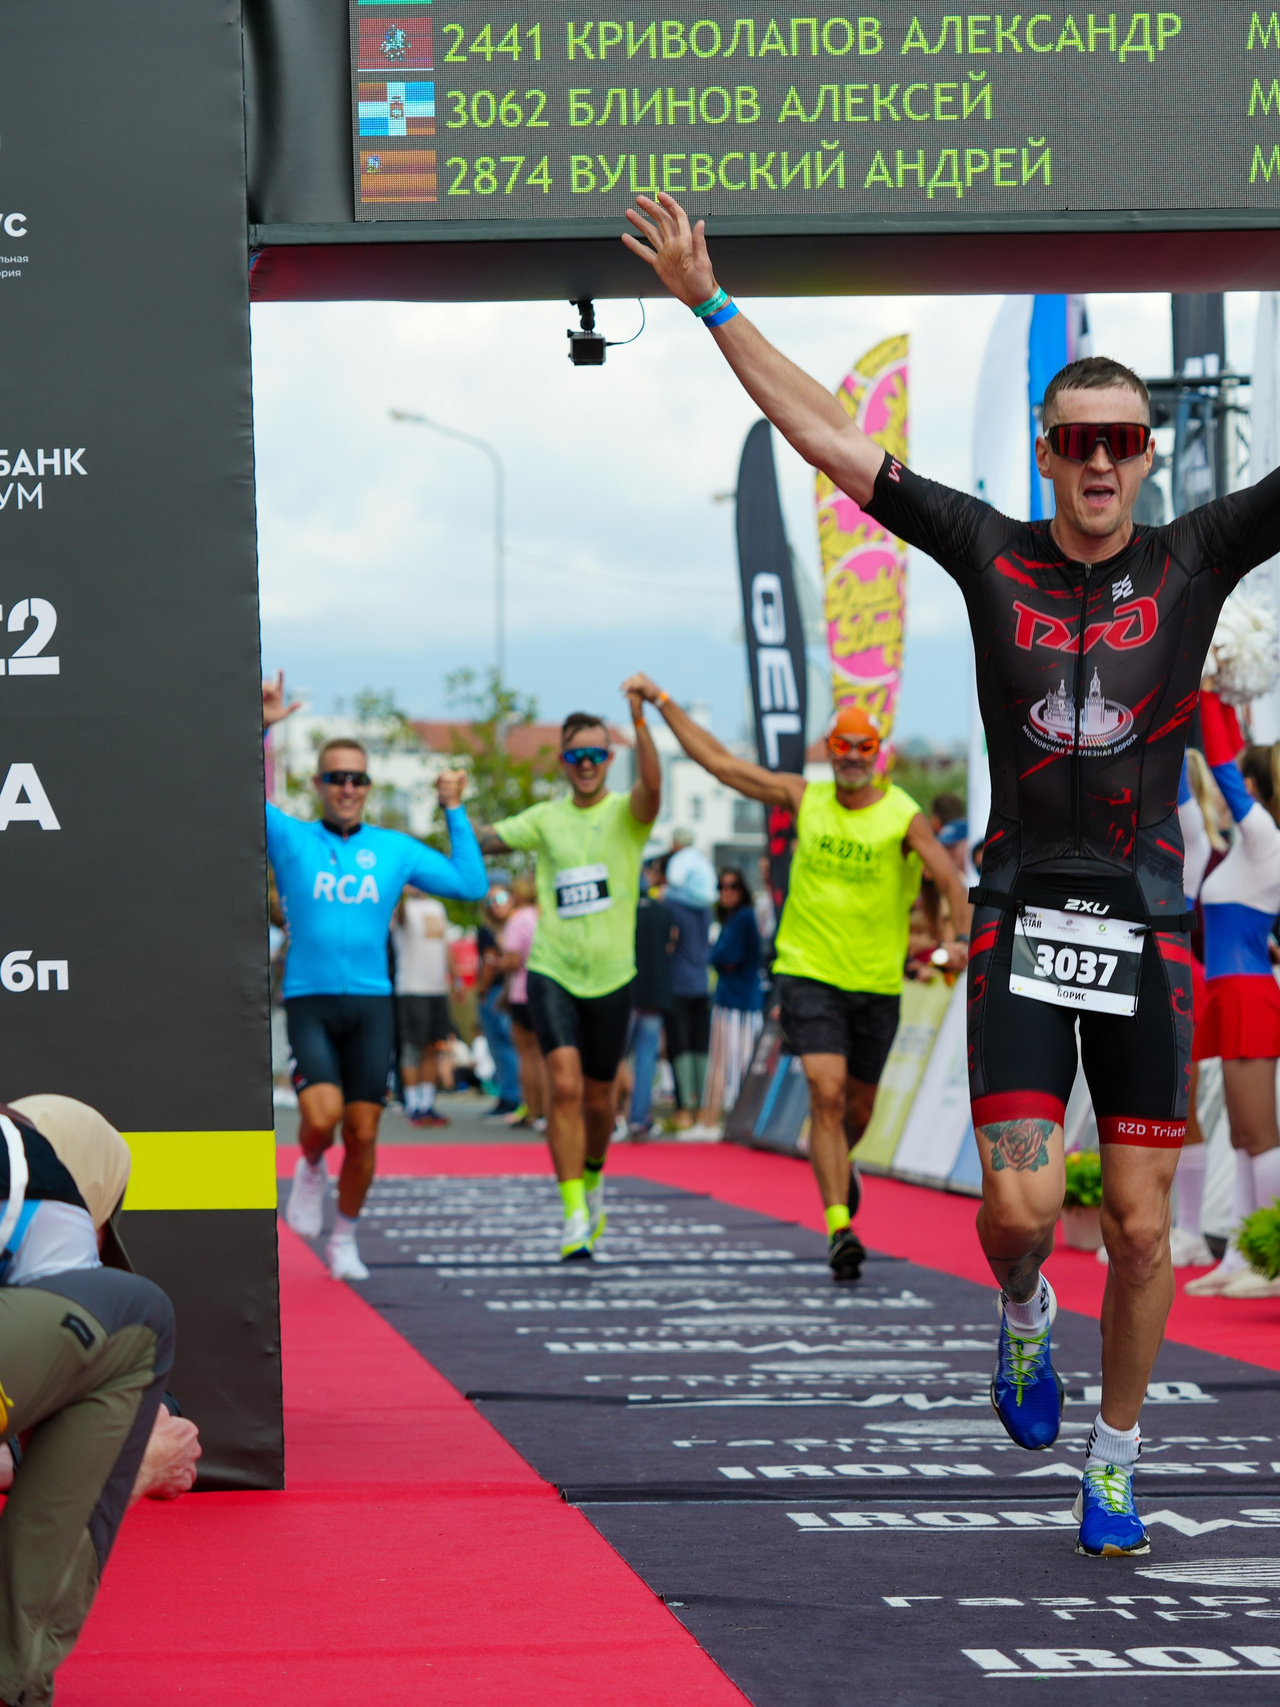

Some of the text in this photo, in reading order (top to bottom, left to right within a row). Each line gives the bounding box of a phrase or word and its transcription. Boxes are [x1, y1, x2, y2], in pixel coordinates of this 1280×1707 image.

[442, 22, 543, 62] 2441
[568, 17, 883, 59] КРИВОЛАПОВ
[901, 11, 1183, 63] АЛЕКСАНДР
[445, 90, 550, 129] 3062
[568, 86, 761, 127] БЛИНОВ
[778, 71, 993, 123] АЛЕКСЕЙ
[446, 155, 553, 196] 2874
[570, 139, 846, 202] ВУЦЕВСКИЙ
[865, 136, 1052, 199] АНДРЕЙ
[0, 269, 22, 279] рия
[1022, 724, 1065, 755] МОСКОВСКАЯ
[1113, 733, 1138, 754] ДОРОГА
[313, 871, 380, 905] RCA
[1064, 898, 1110, 915] 2XU
[1033, 944, 1119, 987] 3037
[1117, 1121, 1147, 1135] RZD
[717, 1462, 997, 1480] IRON
[786, 1509, 1075, 1527] IRON
